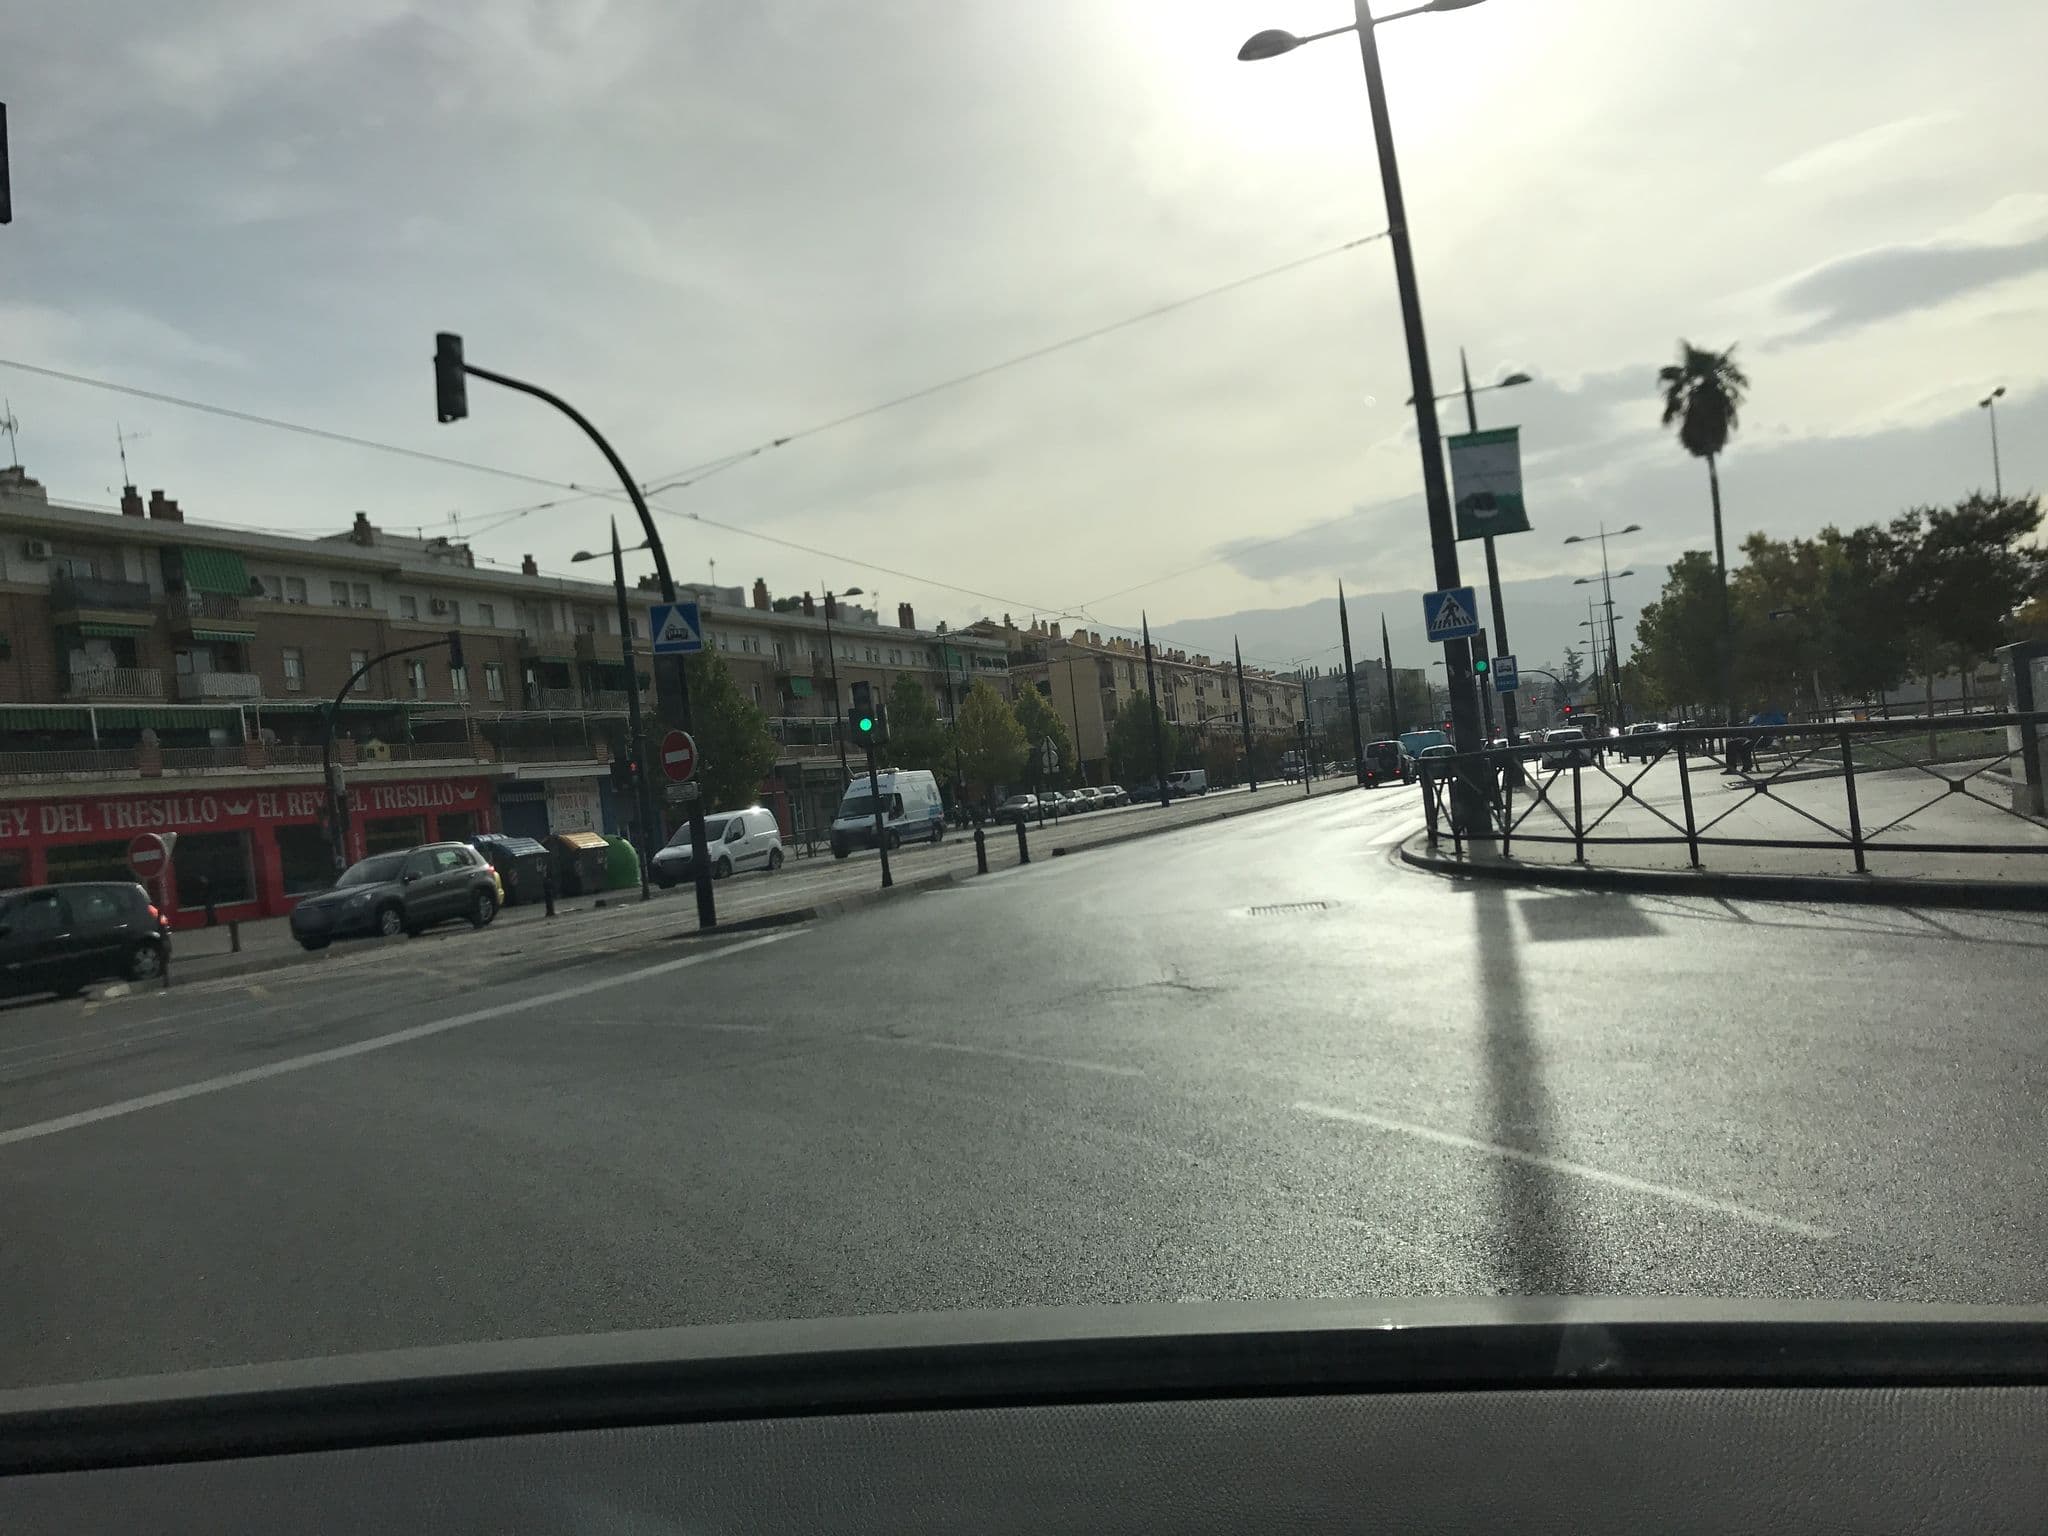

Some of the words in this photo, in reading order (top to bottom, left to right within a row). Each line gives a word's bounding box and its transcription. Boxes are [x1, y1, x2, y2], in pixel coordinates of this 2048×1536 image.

[40, 803, 93, 835] DEL
[97, 796, 218, 831] TRESILLO
[257, 791, 283, 819] EL
[370, 782, 454, 811] TRESILLO
